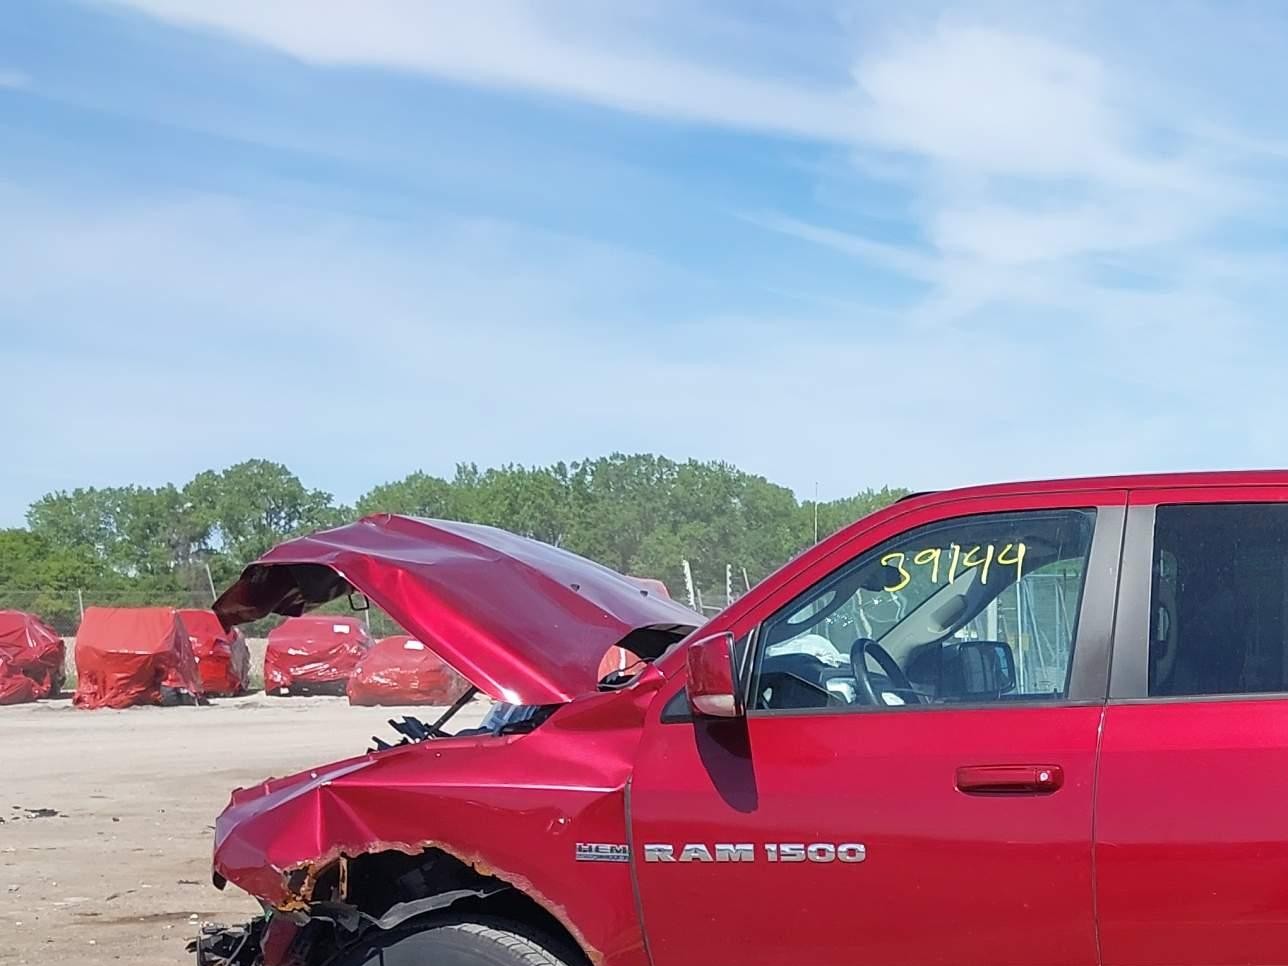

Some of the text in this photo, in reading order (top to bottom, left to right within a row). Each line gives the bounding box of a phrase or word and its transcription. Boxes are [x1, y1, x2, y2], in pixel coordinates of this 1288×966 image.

[881, 543, 1026, 592] 39144
[644, 843, 866, 862] RAM 1500
